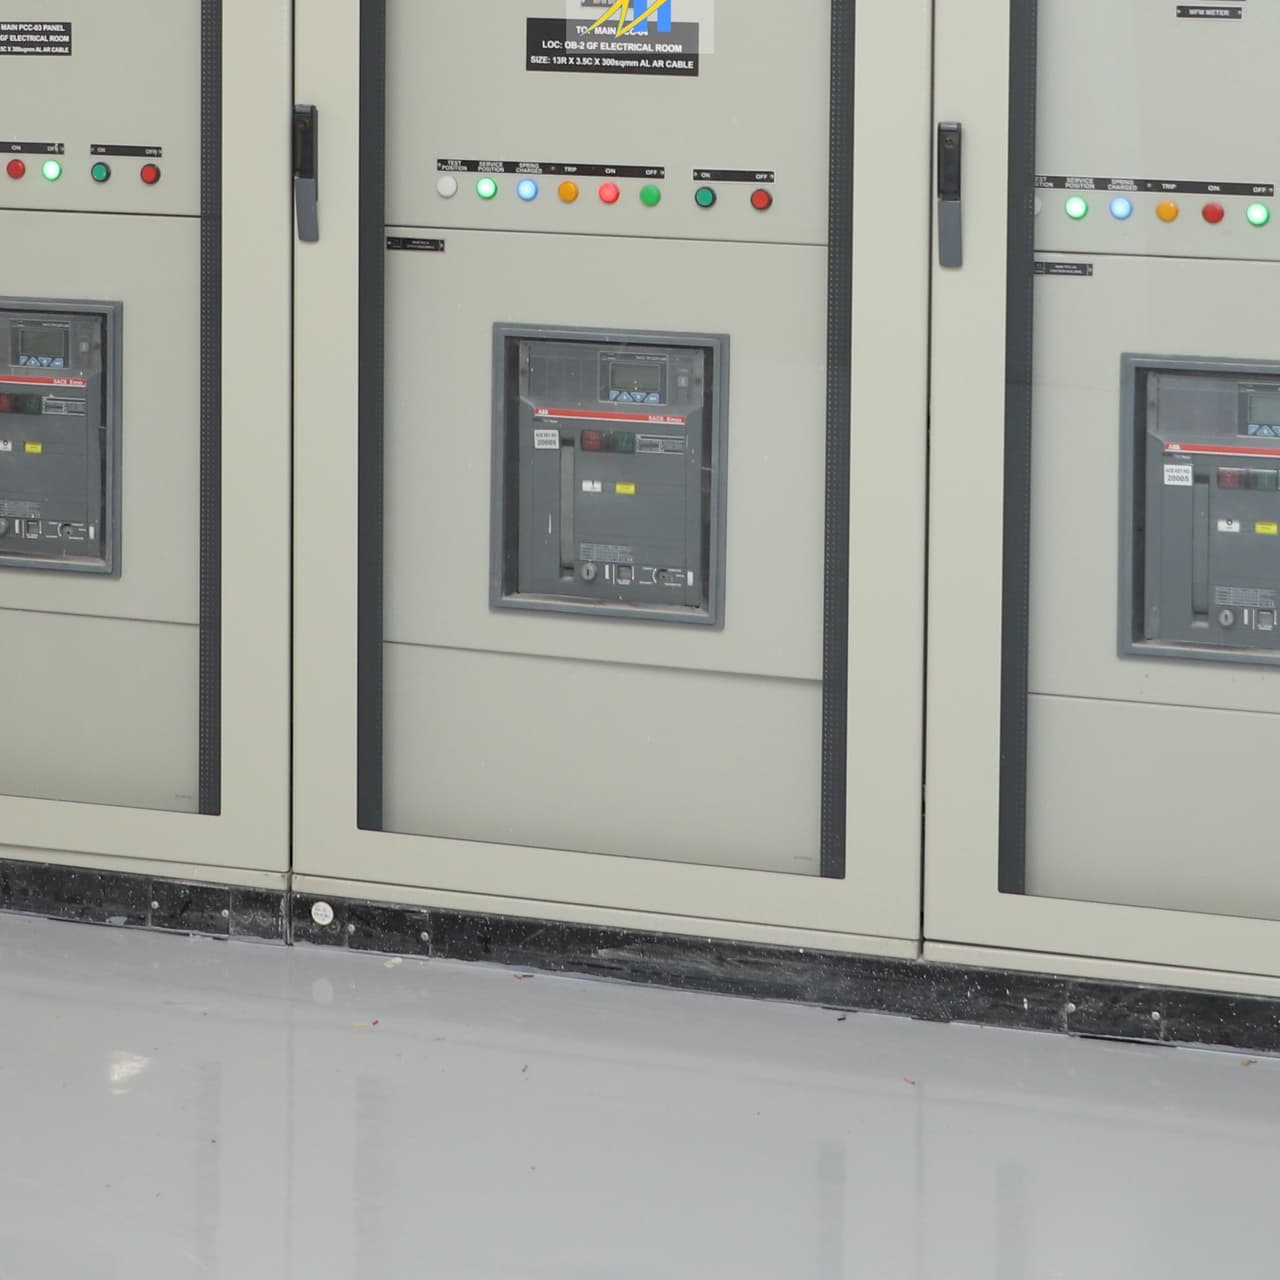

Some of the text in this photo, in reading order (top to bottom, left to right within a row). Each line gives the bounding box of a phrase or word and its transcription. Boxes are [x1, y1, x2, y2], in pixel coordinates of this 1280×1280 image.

[594, 26, 616, 35] MAIN
[542, 40, 682, 53] LOC: OB-2 GF ELECTRICAL ROOM
[530, 55, 551, 64] SIZE:
[569, 56, 574, 64] X
[595, 57, 600, 65] X
[602, 58, 639, 68] 300sqmm
[640, 59, 650, 67] AL
[652, 59, 664, 68] AR
[666, 60, 694, 69] CABLE
